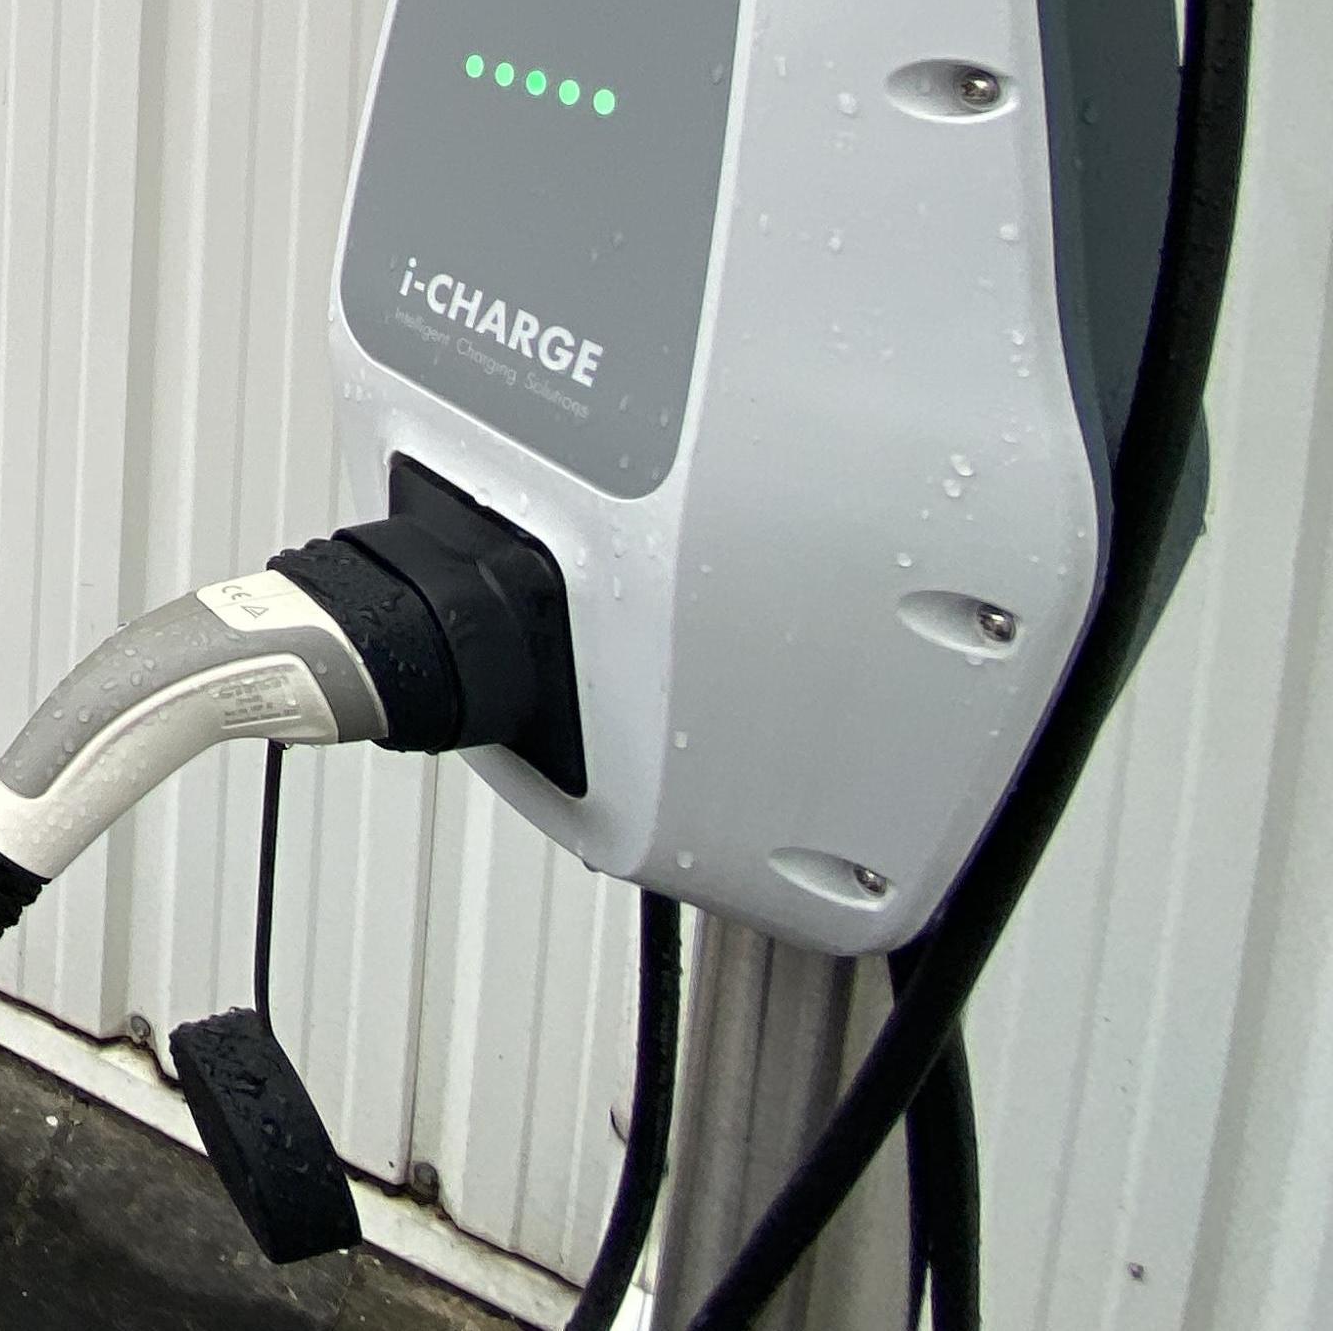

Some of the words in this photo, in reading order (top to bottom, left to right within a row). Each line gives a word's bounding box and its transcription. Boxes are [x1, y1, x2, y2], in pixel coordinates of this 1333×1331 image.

[394, 308, 451, 346] Intelligent
[455, 337, 518, 386] Charging
[524, 372, 591, 419] Solutions
[399, 257, 604, 388] i-CHARGE
